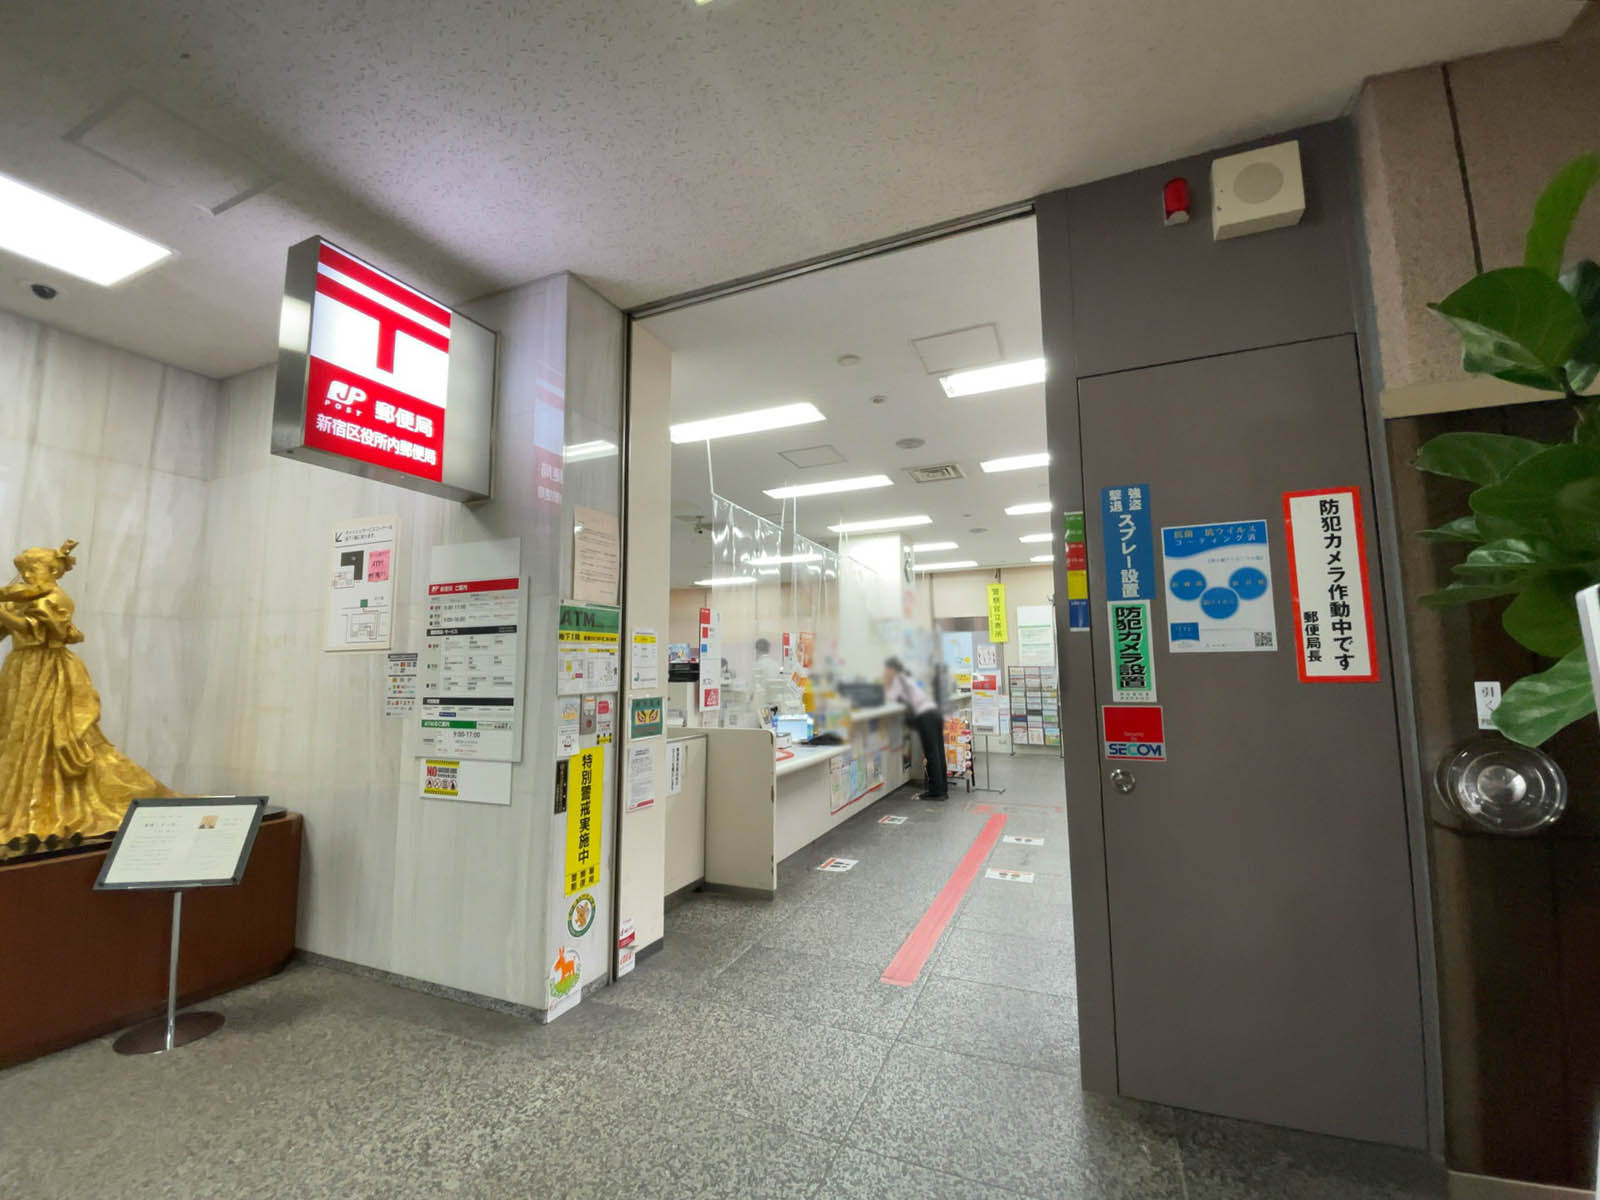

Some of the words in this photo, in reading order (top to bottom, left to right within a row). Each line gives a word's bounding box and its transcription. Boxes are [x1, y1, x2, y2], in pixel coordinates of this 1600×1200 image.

[325, 400, 362, 417] POST
[327, 381, 367, 405] JP
[374, 400, 433, 438] 郵便局
[316, 413, 437, 466] 新宿区役所内郵便局
[1108, 489, 1123, 513] 撃退
[1128, 487, 1142, 511] 強盗
[1118, 514, 1140, 598] スプレー設置
[1319, 499, 1355, 671] 防犯カメラ作動中です
[560, 609, 596, 627] ATM
[1303, 611, 1322, 662] 郵便局長
[1116, 607, 1145, 688] 防犯カメラ設置
[1108, 743, 1162, 757] SECOM
[578, 753, 593, 865] 特別警戒実施中
